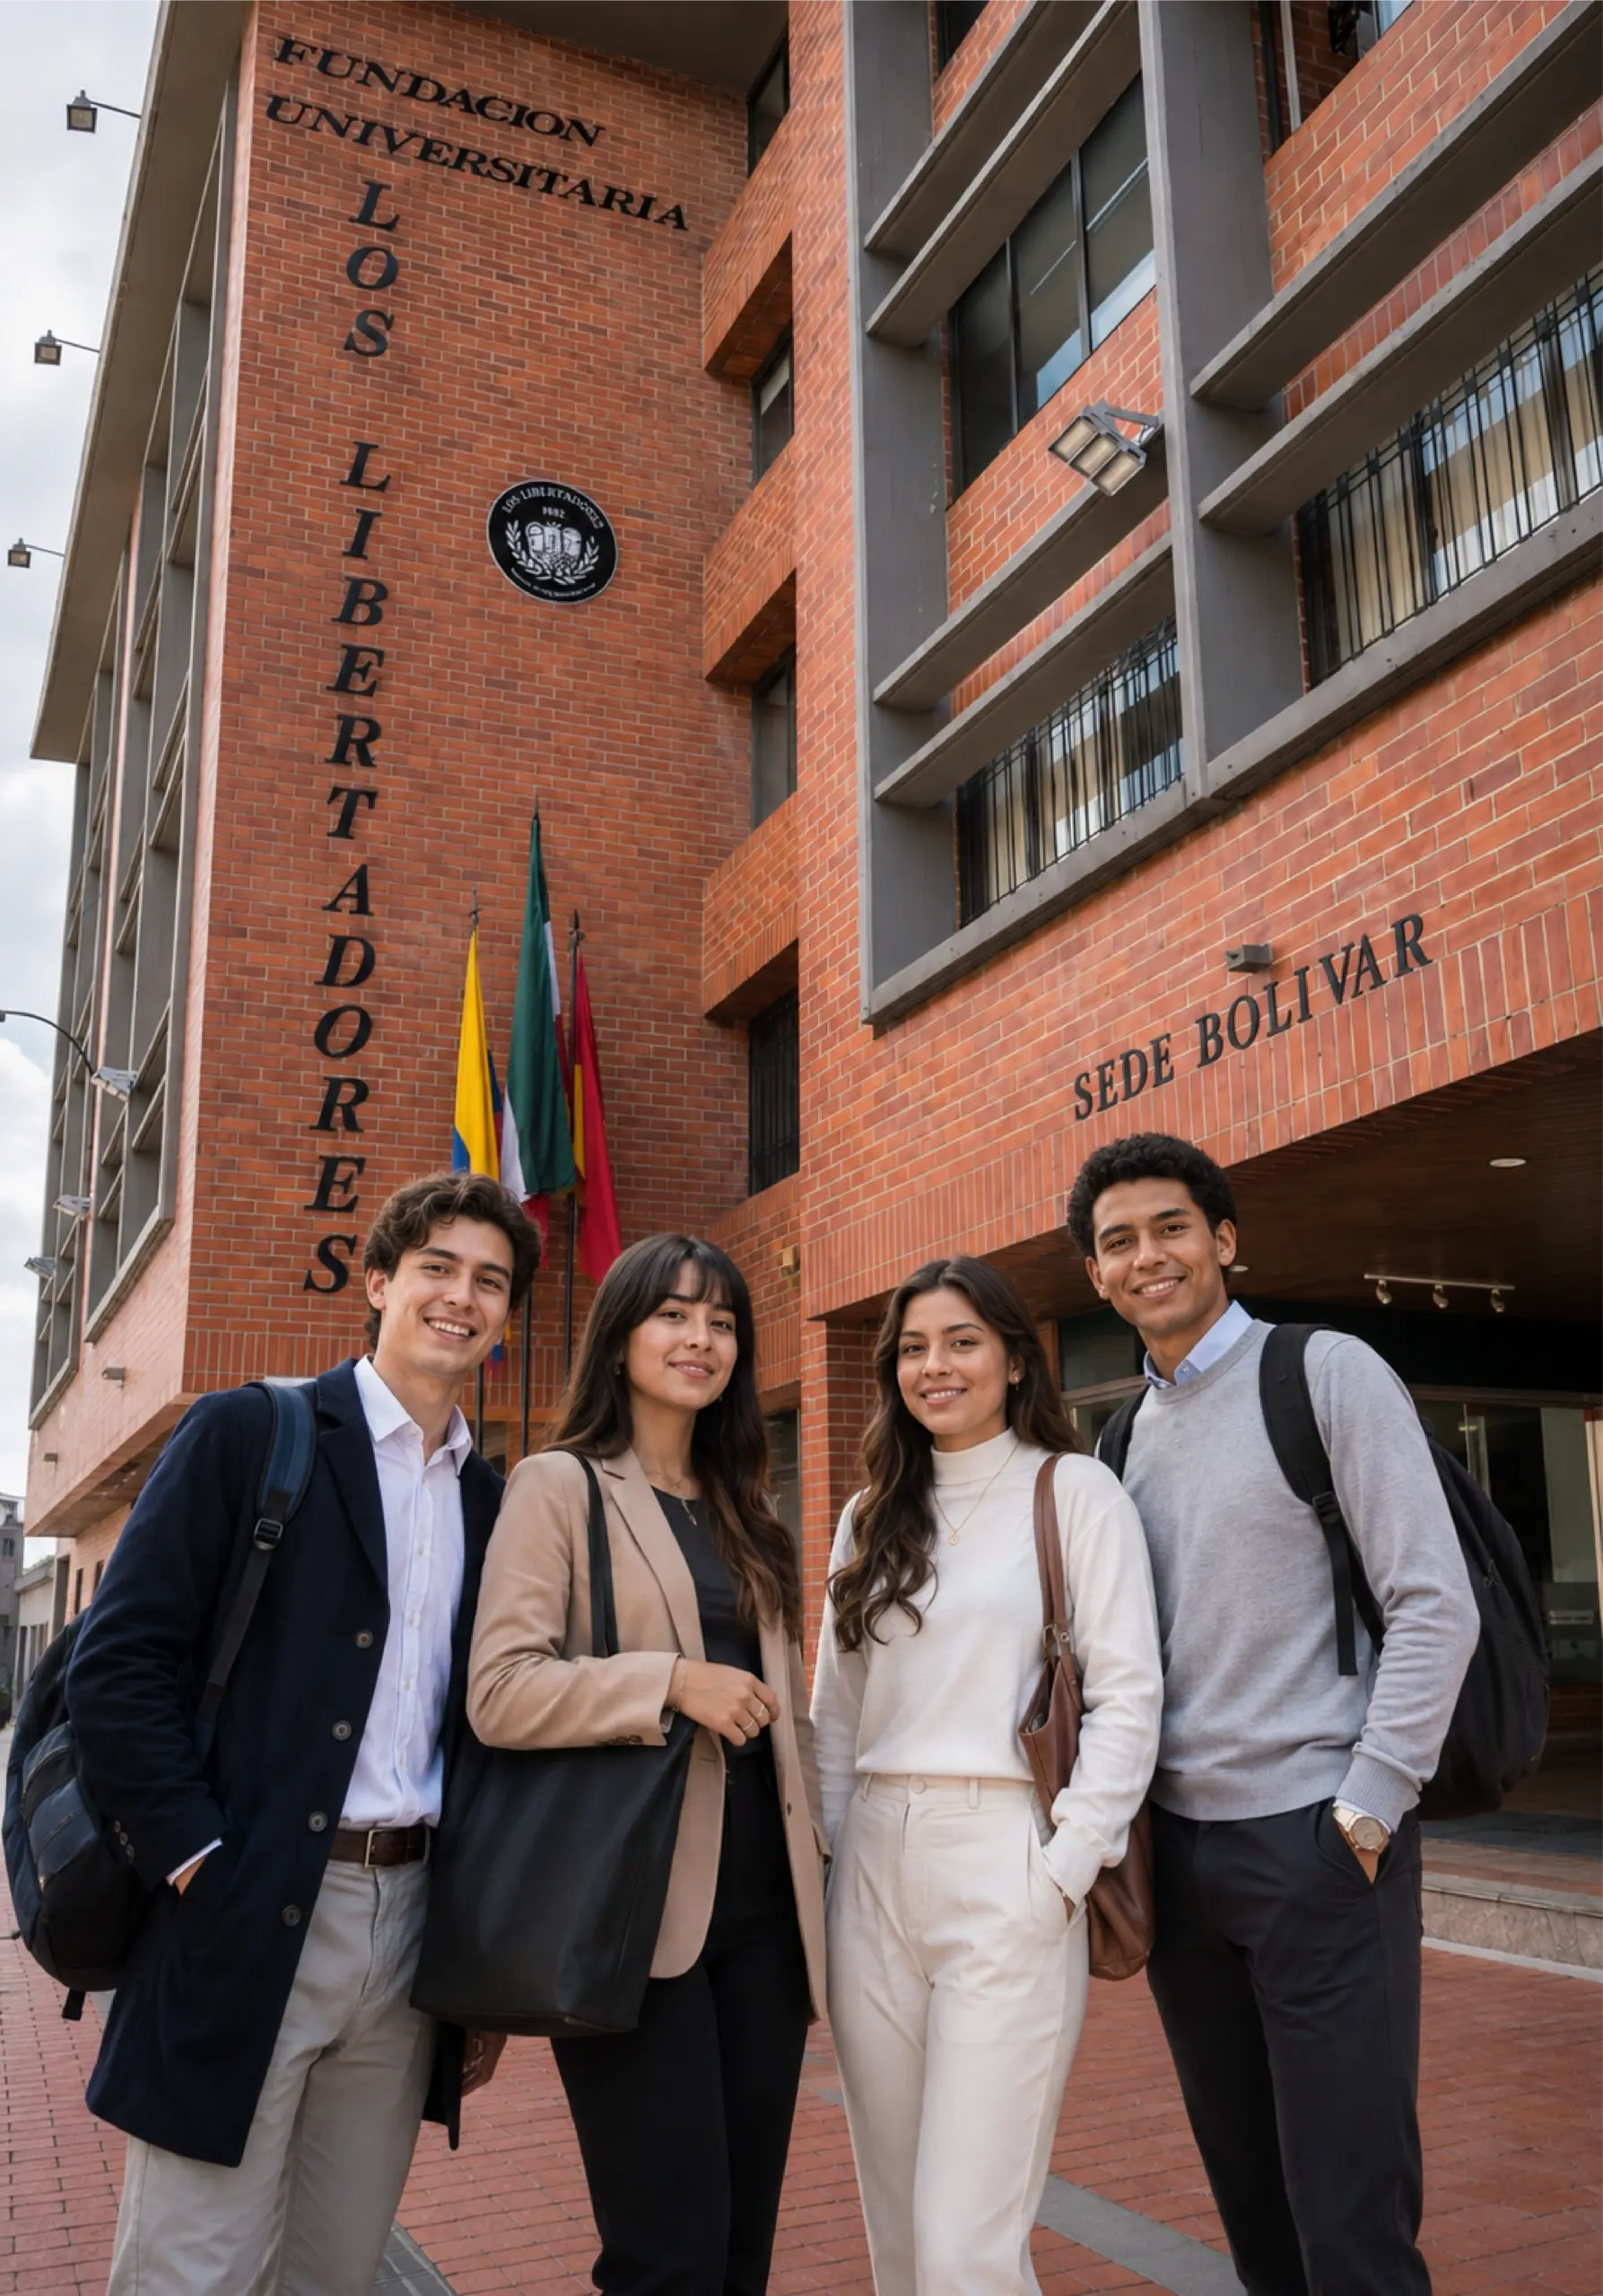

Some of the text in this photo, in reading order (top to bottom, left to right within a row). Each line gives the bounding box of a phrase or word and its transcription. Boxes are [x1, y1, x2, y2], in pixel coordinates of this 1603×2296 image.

[266, 94, 690, 231] UNIVERSITARIA
[274, 36, 605, 147] FUNDACION
[303, 180, 400, 1293] LOS LIBERTADORES
[1074, 913, 1433, 1121] SEDE BOLIVAR
